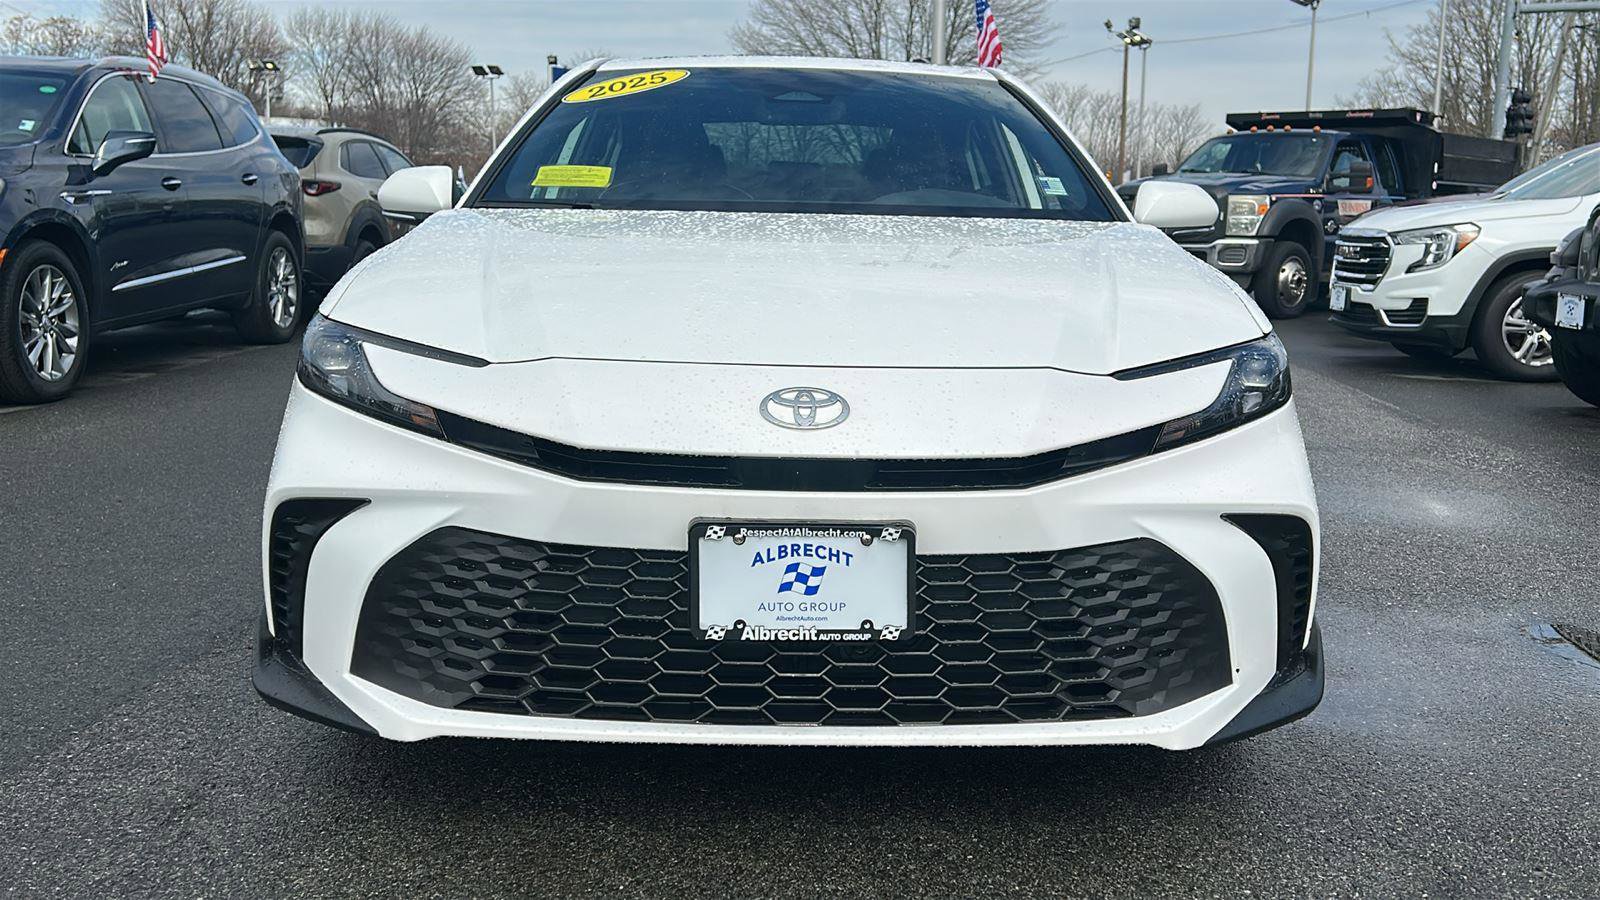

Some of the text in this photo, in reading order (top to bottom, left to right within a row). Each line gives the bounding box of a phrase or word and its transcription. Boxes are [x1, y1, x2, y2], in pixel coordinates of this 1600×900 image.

[588, 72, 667, 98] 2025
[740, 527, 866, 538] RespectAtAlbrecht.com
[751, 543, 853, 567] ALBRECHT
[757, 602, 846, 611] AUTO GROUP
[741, 625, 872, 641] Albrecht AUTO GROUP
